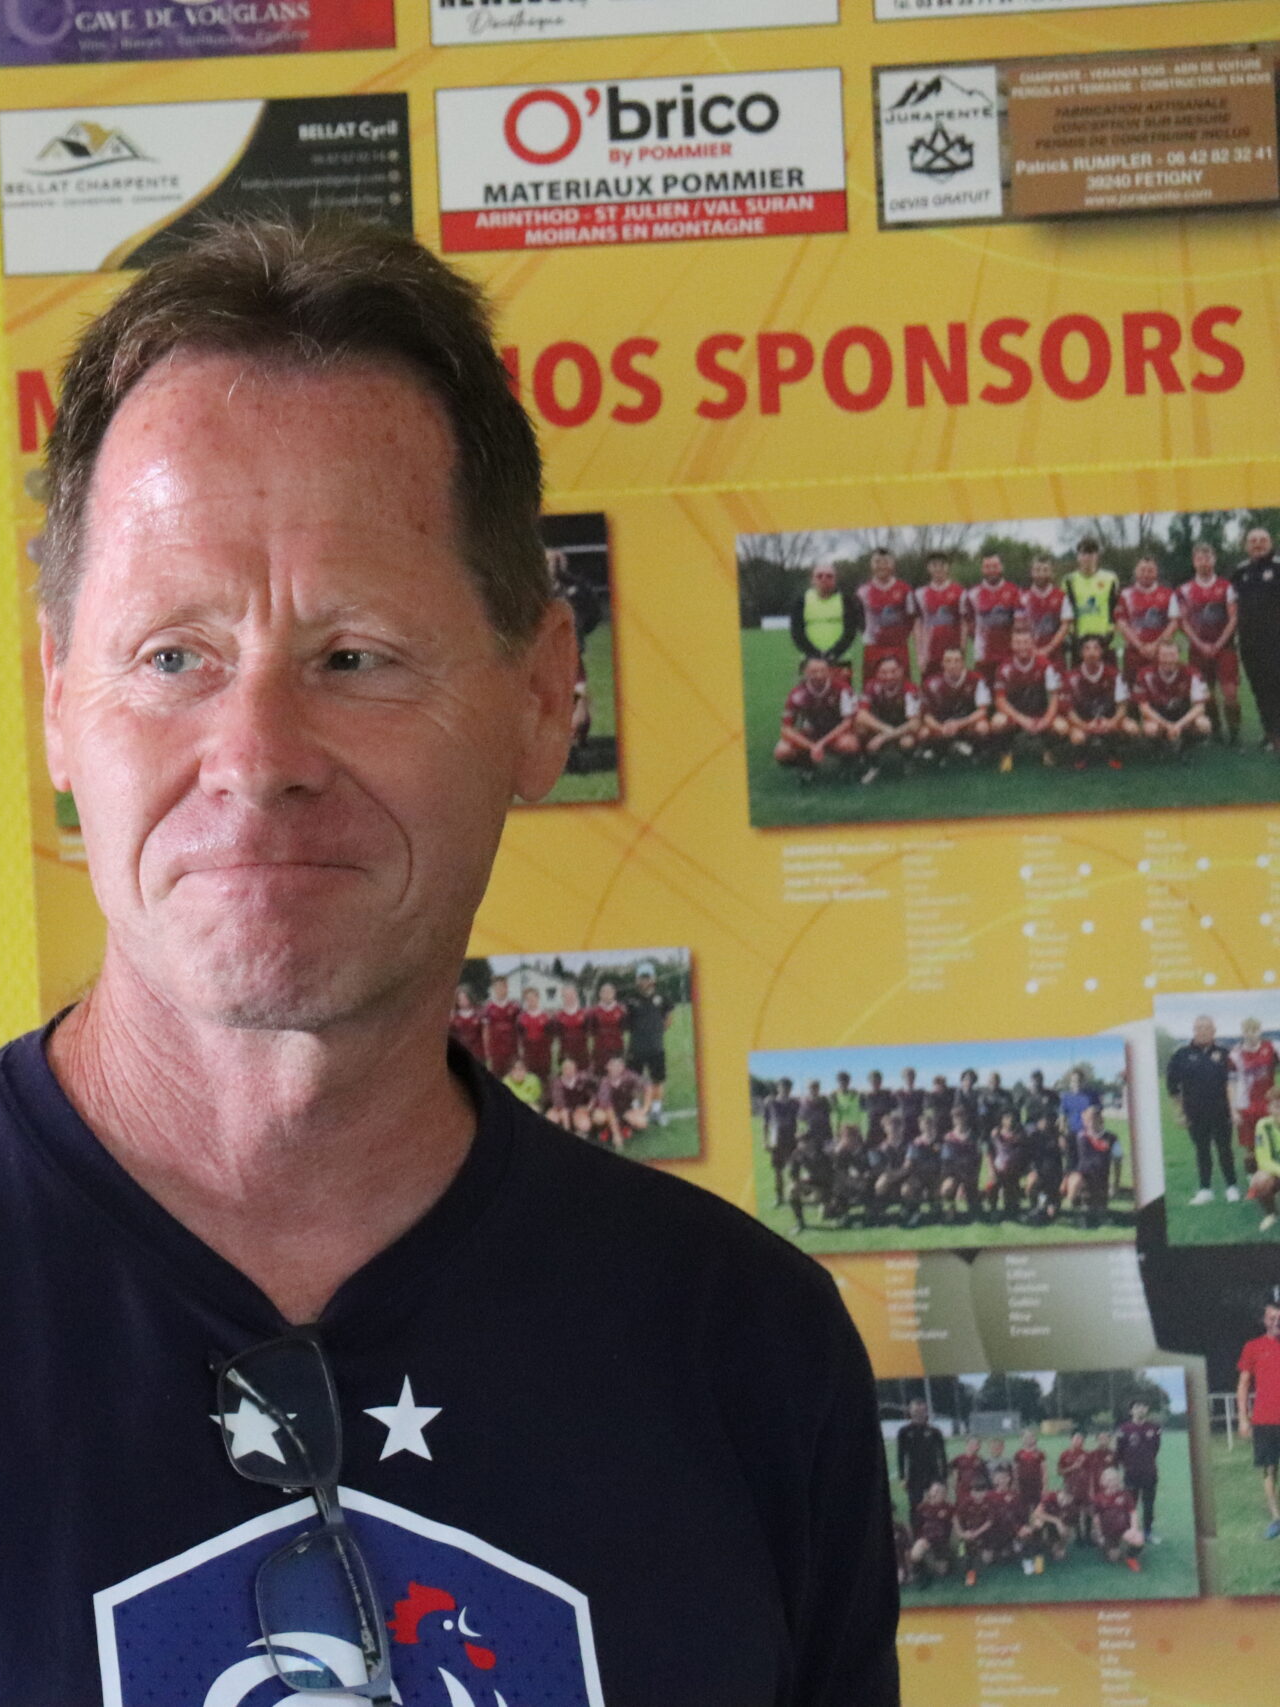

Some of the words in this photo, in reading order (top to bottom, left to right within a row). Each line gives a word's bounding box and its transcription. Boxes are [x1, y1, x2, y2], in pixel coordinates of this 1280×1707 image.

[74, 9, 136, 32] CAVE
[145, 7, 178, 29] DE
[184, 1, 311, 26] VOUGLANS
[299, 122, 357, 141] BELLAT
[359, 119, 399, 141] Cyril
[609, 149, 631, 166] By
[639, 143, 733, 162] POMMIER
[1015, 158, 1069, 176] Patrick
[1073, 152, 1153, 172] RUMPLER
[1189, 149, 1208, 165] 42
[5, 180, 69, 195] BELLAT
[74, 174, 181, 193] CHARPENTE
[483, 176, 652, 205] MATERIAUX
[663, 168, 804, 197] POMMIER
[1135, 169, 1204, 187] FETIGNY
[475, 209, 580, 229] ARINTHOD
[594, 206, 618, 223] ST
[623, 202, 690, 221] JULIEN
[703, 198, 740, 217] VAL
[745, 195, 815, 215] SURAN
[889, 196, 928, 211] DEVIS
[932, 189, 991, 207] GRATUIT
[524, 227, 618, 247] MOIRANS
[622, 225, 648, 242] EN
[652, 217, 766, 240] MONTAGNE
[500, 336, 664, 428] OS
[695, 305, 1246, 421] SPONSORS
